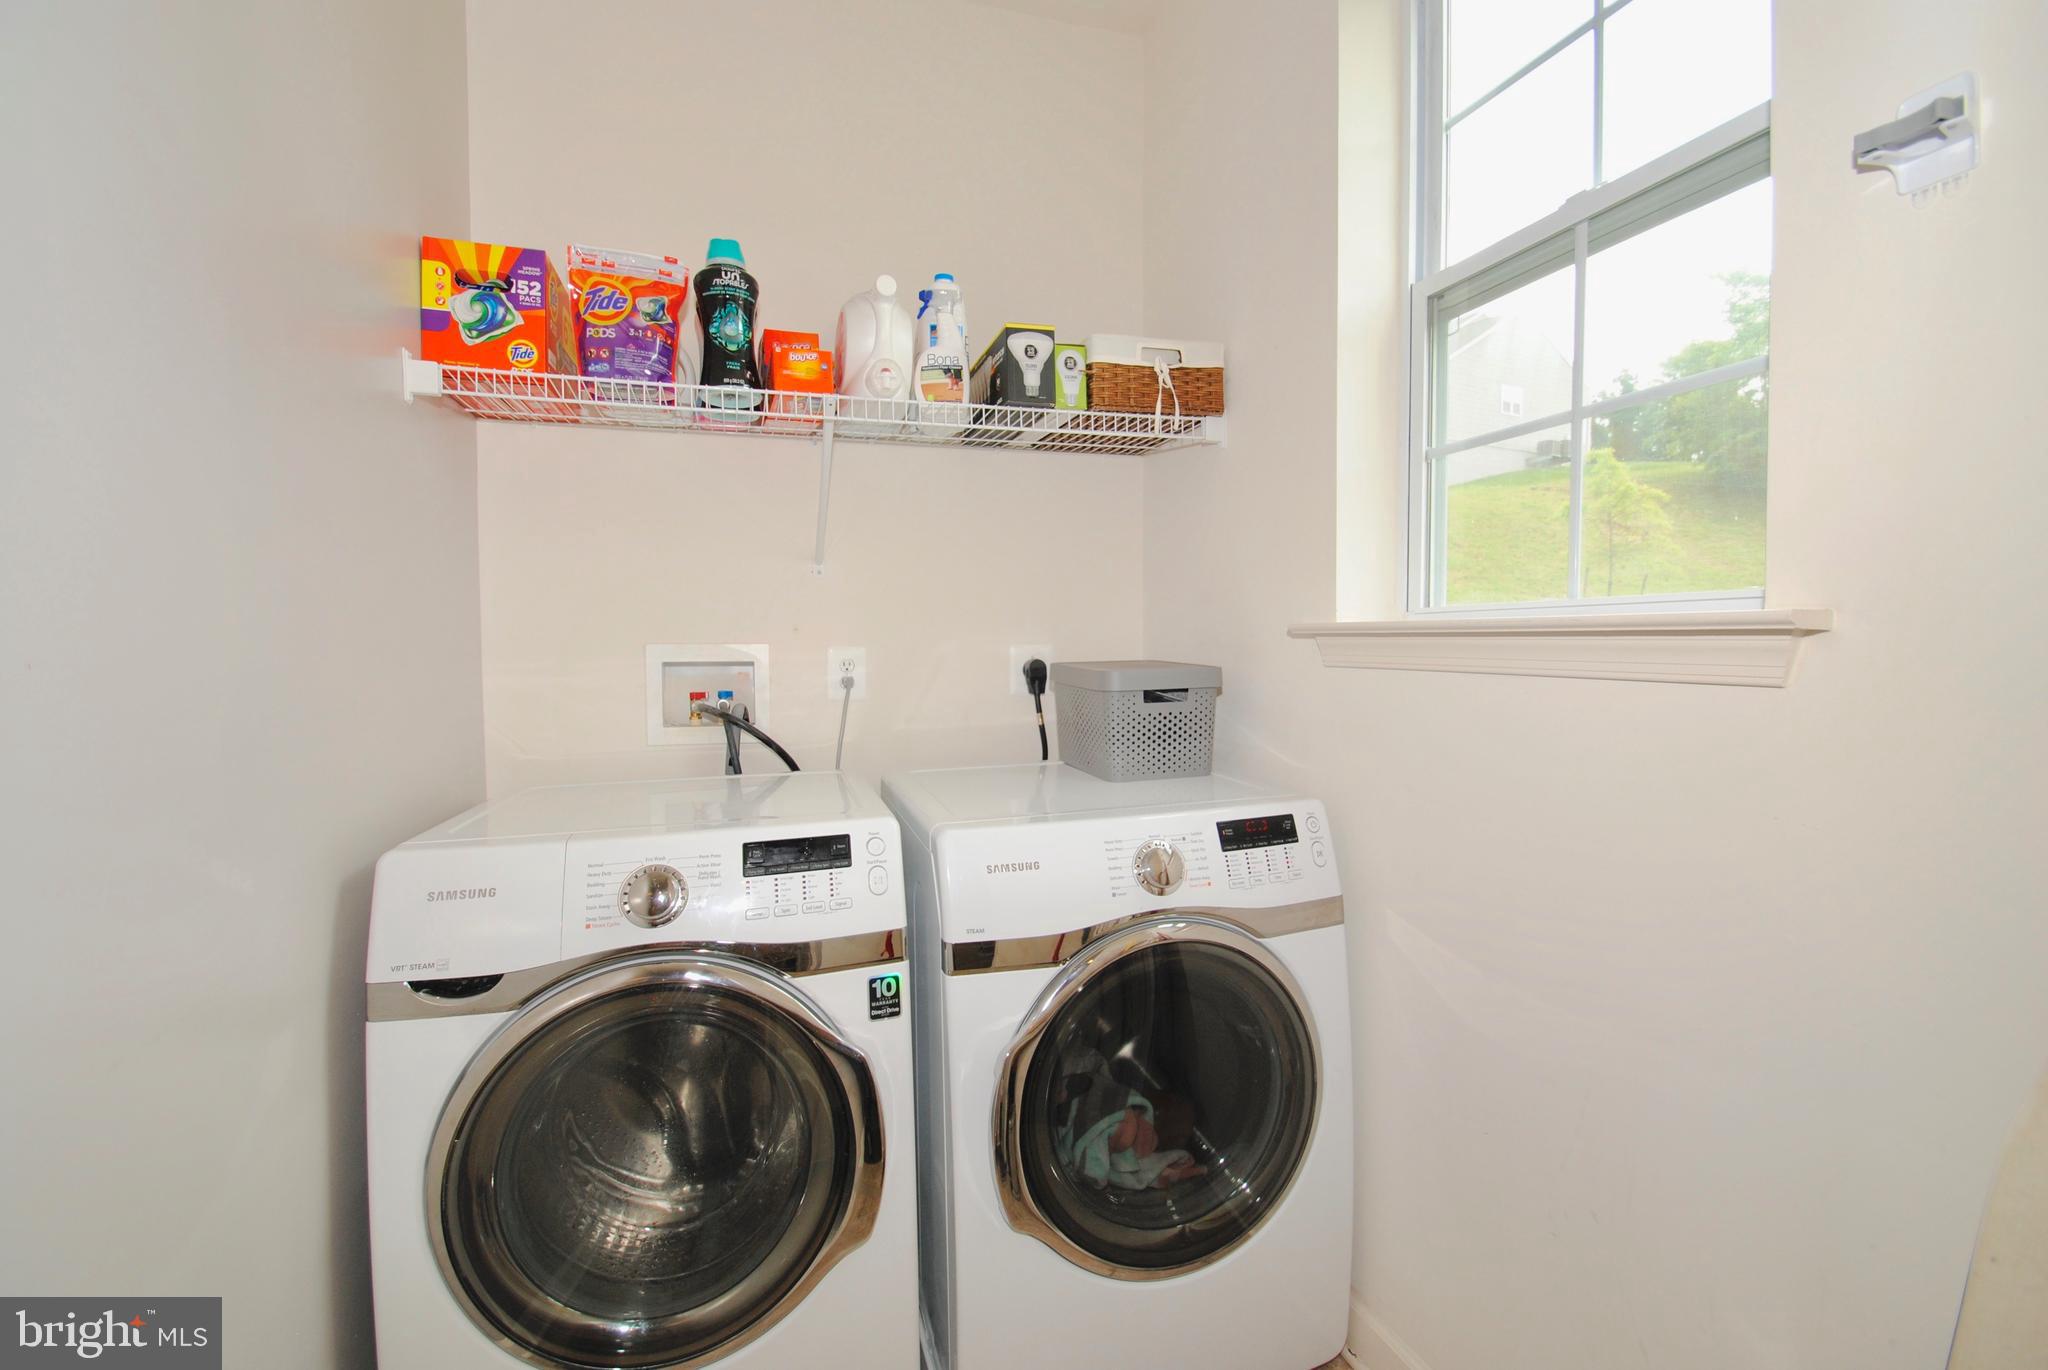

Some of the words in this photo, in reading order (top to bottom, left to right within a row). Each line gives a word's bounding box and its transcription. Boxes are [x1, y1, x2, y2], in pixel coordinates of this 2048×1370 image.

[511, 278, 542, 297] 152
[519, 295, 542, 304] PACS
[583, 287, 628, 316] Tide
[586, 327, 616, 338] PODS
[510, 346, 535, 361] Tide
[789, 351, 818, 362] bounce
[927, 353, 960, 366] Bona
[986, 861, 1040, 874] SAMSUNG
[427, 888, 497, 902] SAMSUNG
[409, 963, 435, 971] STEAM
[872, 977, 897, 998] 10
[871, 998, 899, 1007] WARRANTY
